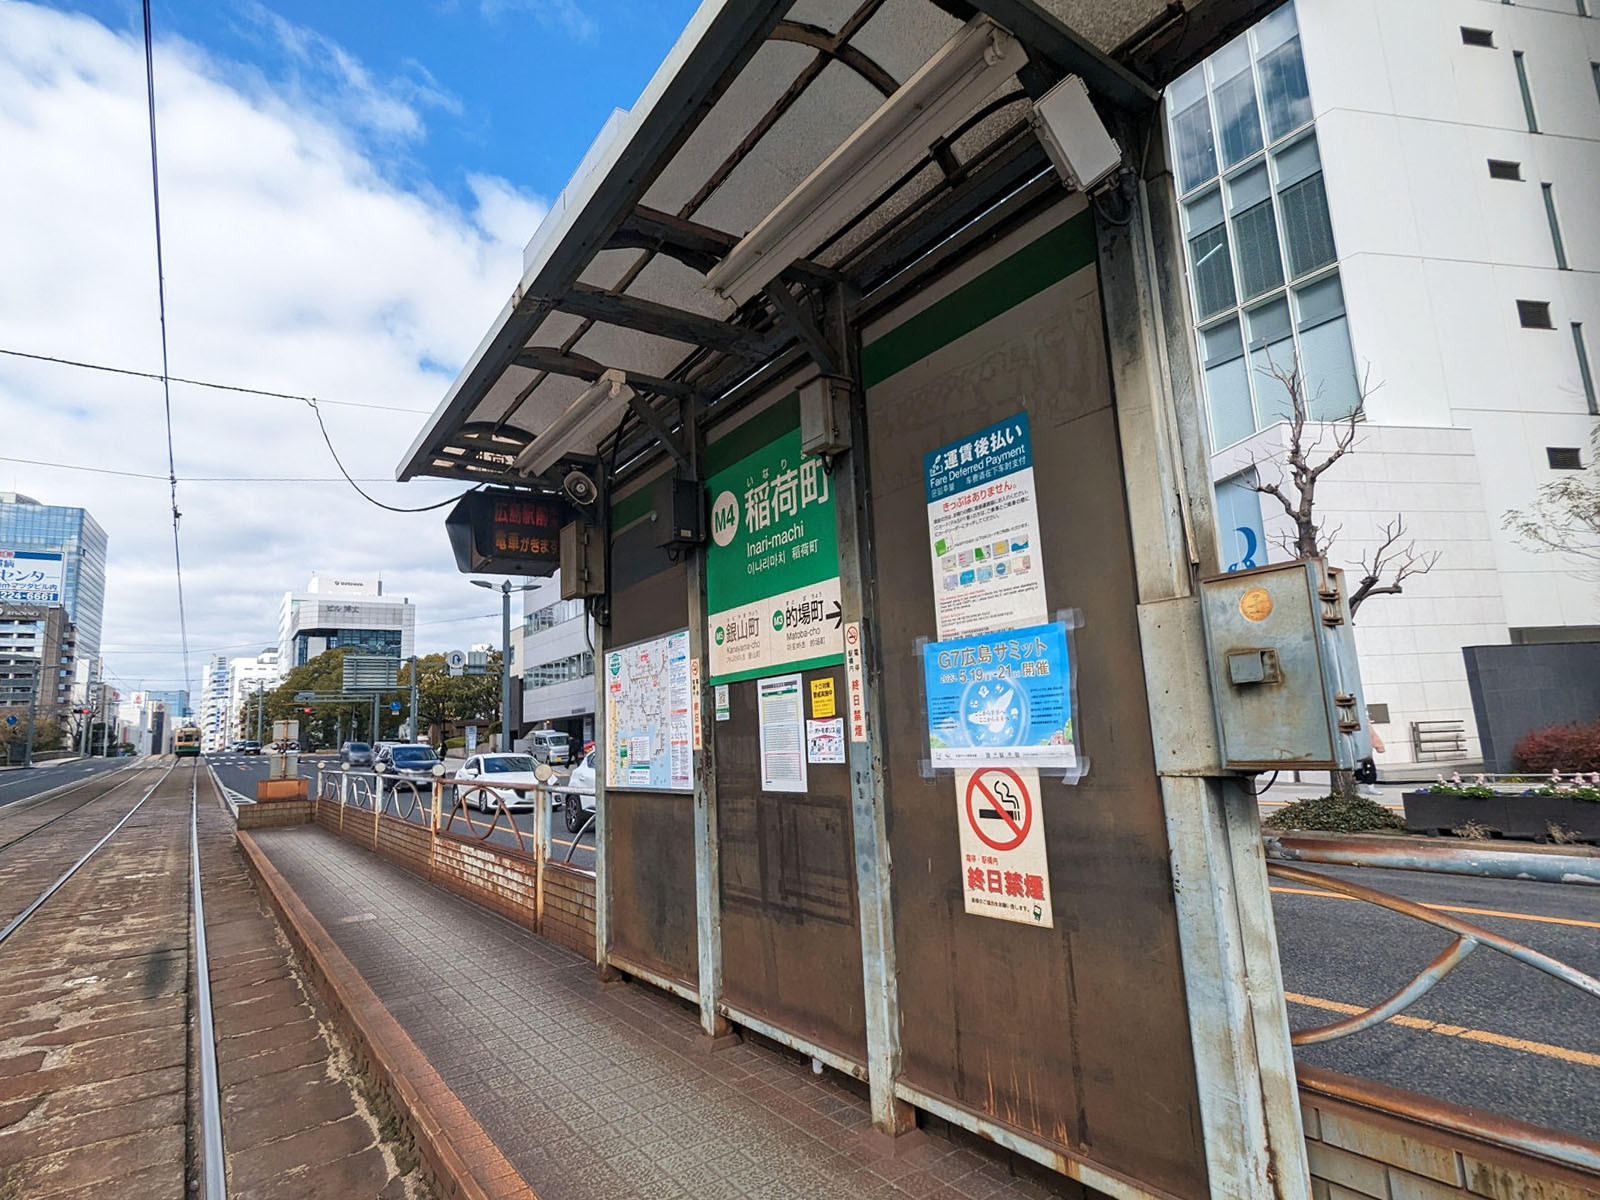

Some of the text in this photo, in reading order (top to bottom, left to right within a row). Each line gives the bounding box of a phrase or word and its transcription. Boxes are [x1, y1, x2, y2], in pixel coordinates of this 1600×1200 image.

[943, 424, 1023, 471] 運賃後払い
[930, 443, 1026, 489] Fare Deferred Payment
[745, 458, 829, 534] 稲荷町
[942, 480, 1018, 513] きっぷはありません。
[714, 503, 735, 533] M4
[746, 519, 804, 558] Inari-machi
[746, 550, 786, 575] 이나리마치
[726, 616, 760, 644] 銀山町
[772, 599, 825, 629] M3 的場町
[786, 626, 821, 642] Matoba-cho
[938, 637, 1048, 670] G7広島サミット
[1022, 660, 1051, 677] 開催
[967, 866, 1046, 902] 終日禁煙
